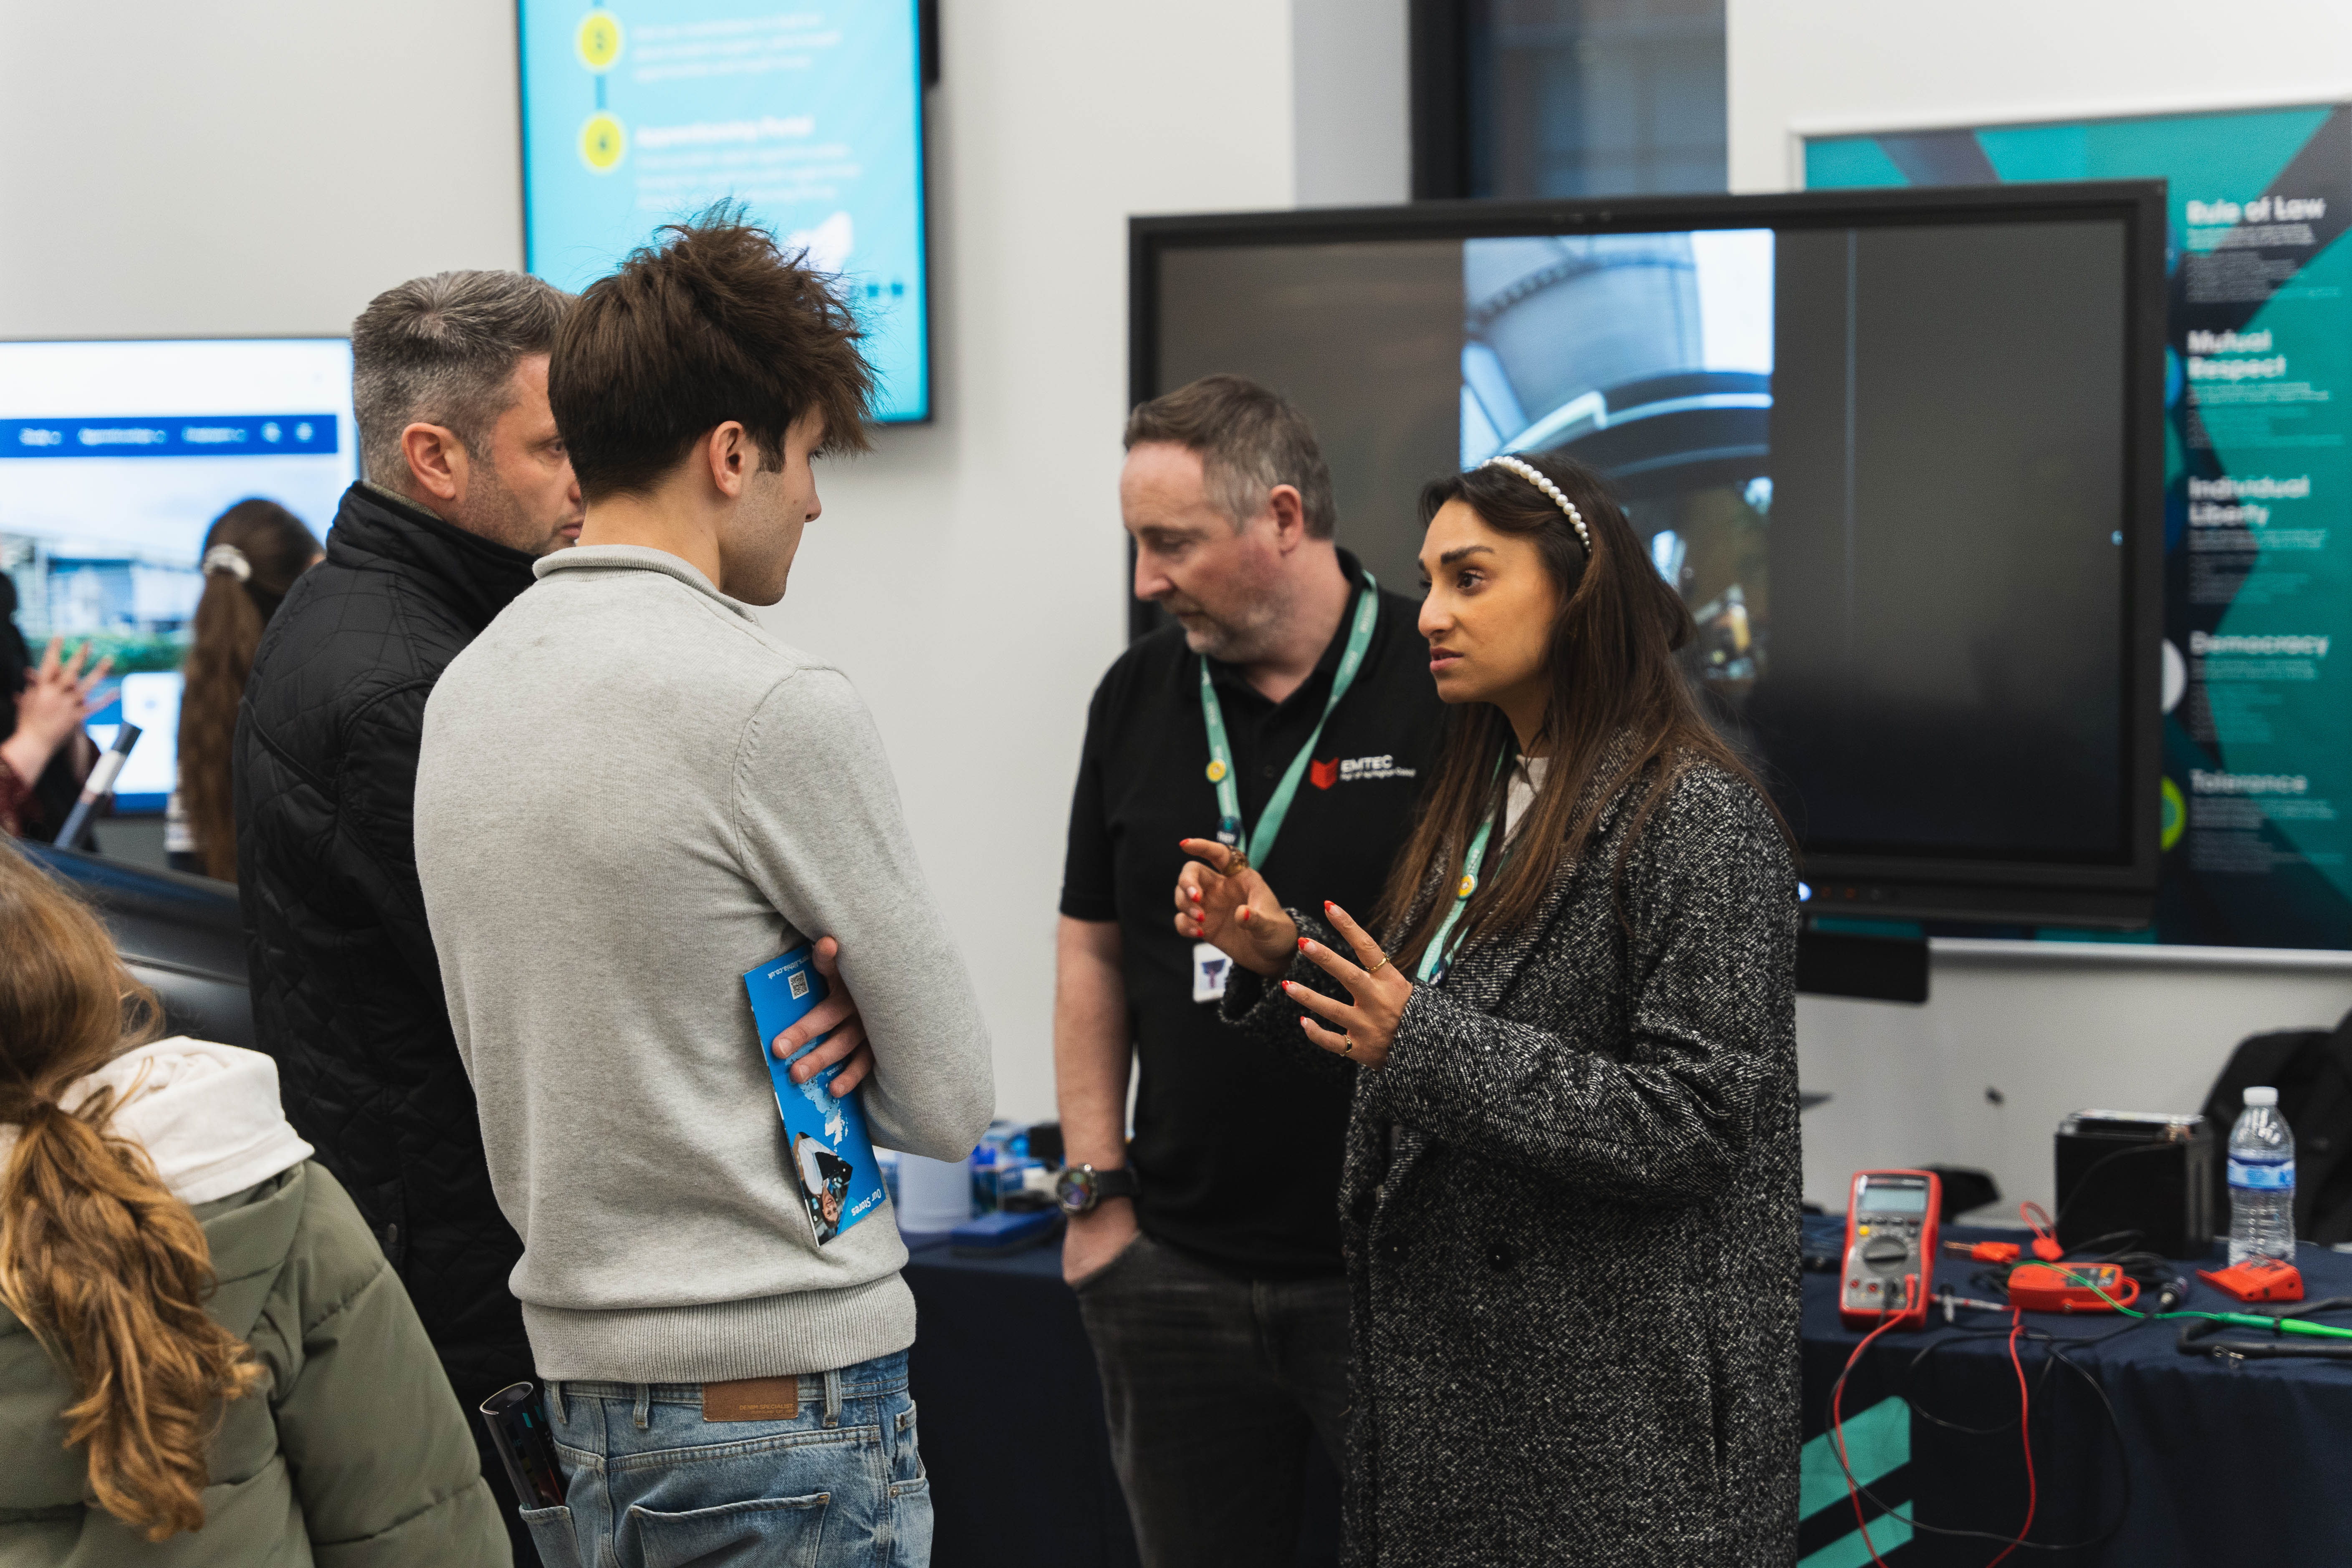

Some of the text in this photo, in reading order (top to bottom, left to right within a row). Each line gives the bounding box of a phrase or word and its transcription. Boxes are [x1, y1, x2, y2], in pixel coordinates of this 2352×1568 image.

[2186, 196, 2325, 225] Rule of Law
[2188, 475, 2310, 499] Individual
[2188, 502, 2270, 528] Liberty
[2189, 631, 2329, 657] Democracy
[1341, 755, 1393, 773] EMTEC
[2190, 769, 2308, 794] Tolerance
[768, 954, 810, 980] ers.lithia.co.uk
[851, 1188, 881, 1216] Our Stores
